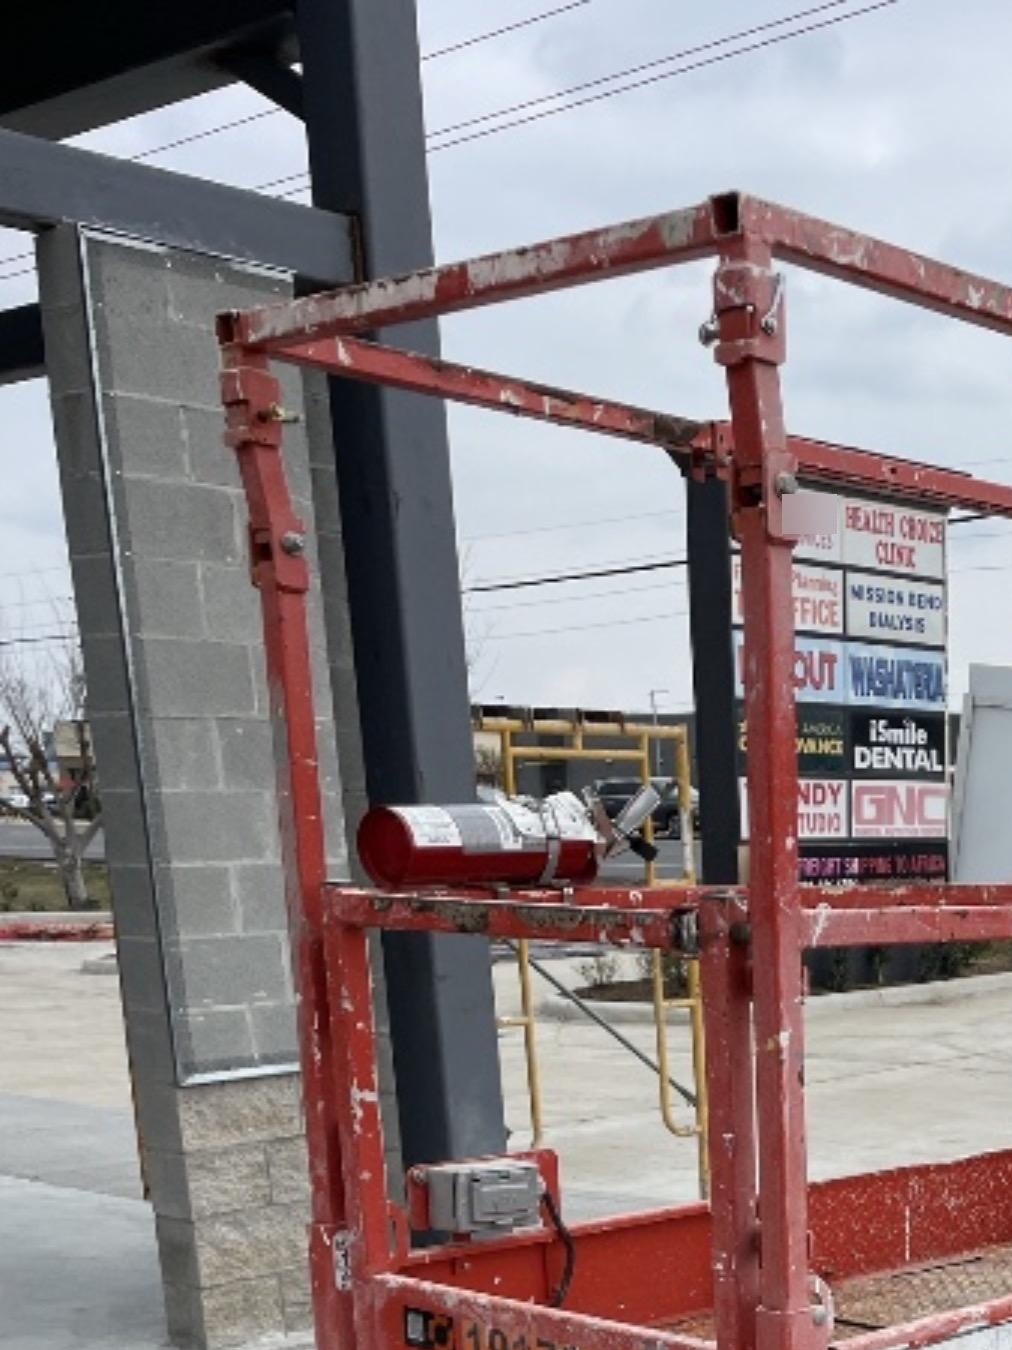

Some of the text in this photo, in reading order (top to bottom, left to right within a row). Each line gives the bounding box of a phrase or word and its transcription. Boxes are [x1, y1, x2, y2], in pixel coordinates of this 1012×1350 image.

[845, 505, 895, 538] HEALTH
[868, 717, 929, 746] iSmile
[854, 746, 944, 773] DENTAL
[854, 785, 950, 826] GNC
